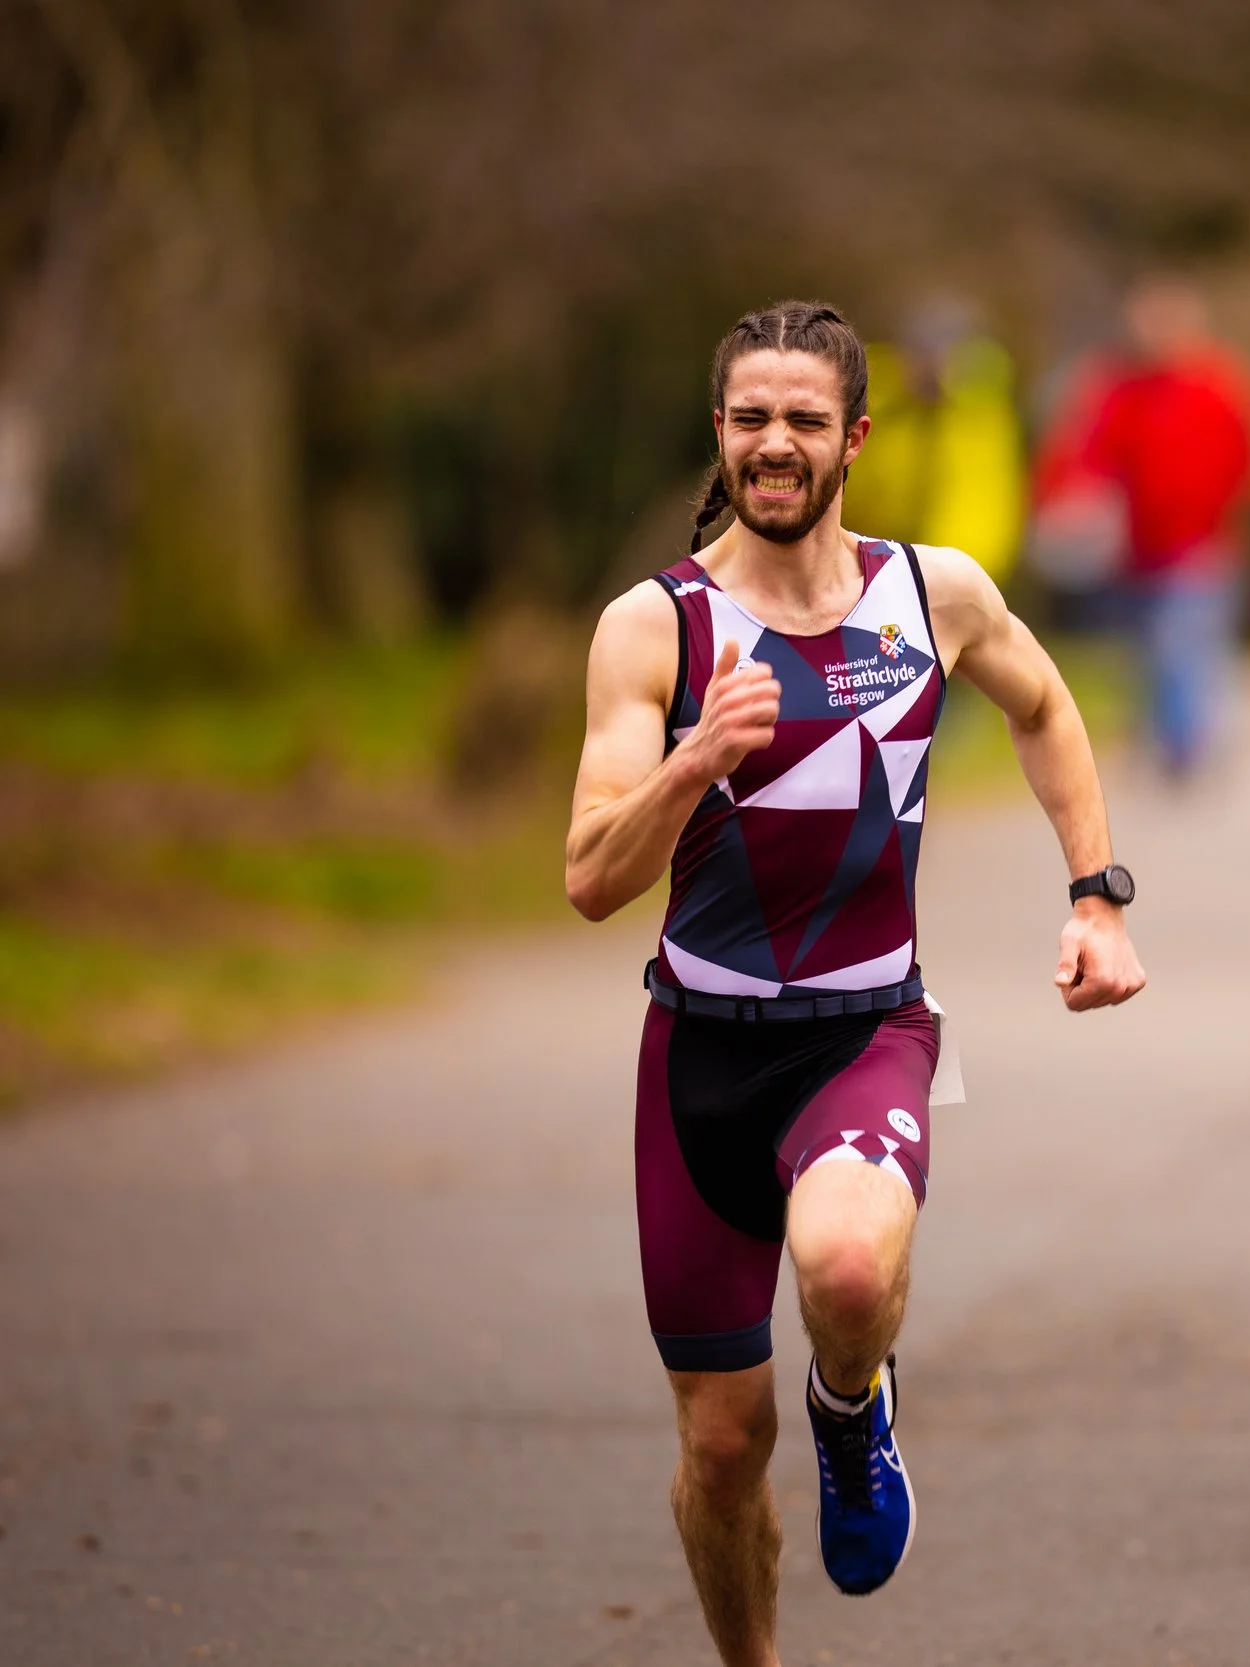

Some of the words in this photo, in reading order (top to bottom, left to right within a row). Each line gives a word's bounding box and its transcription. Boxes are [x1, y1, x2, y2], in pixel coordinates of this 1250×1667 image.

[825, 658, 869, 673] University
[870, 655, 878, 666] of
[825, 663, 917, 691] Strathclyde
[828, 690, 885, 707] Glasgow
